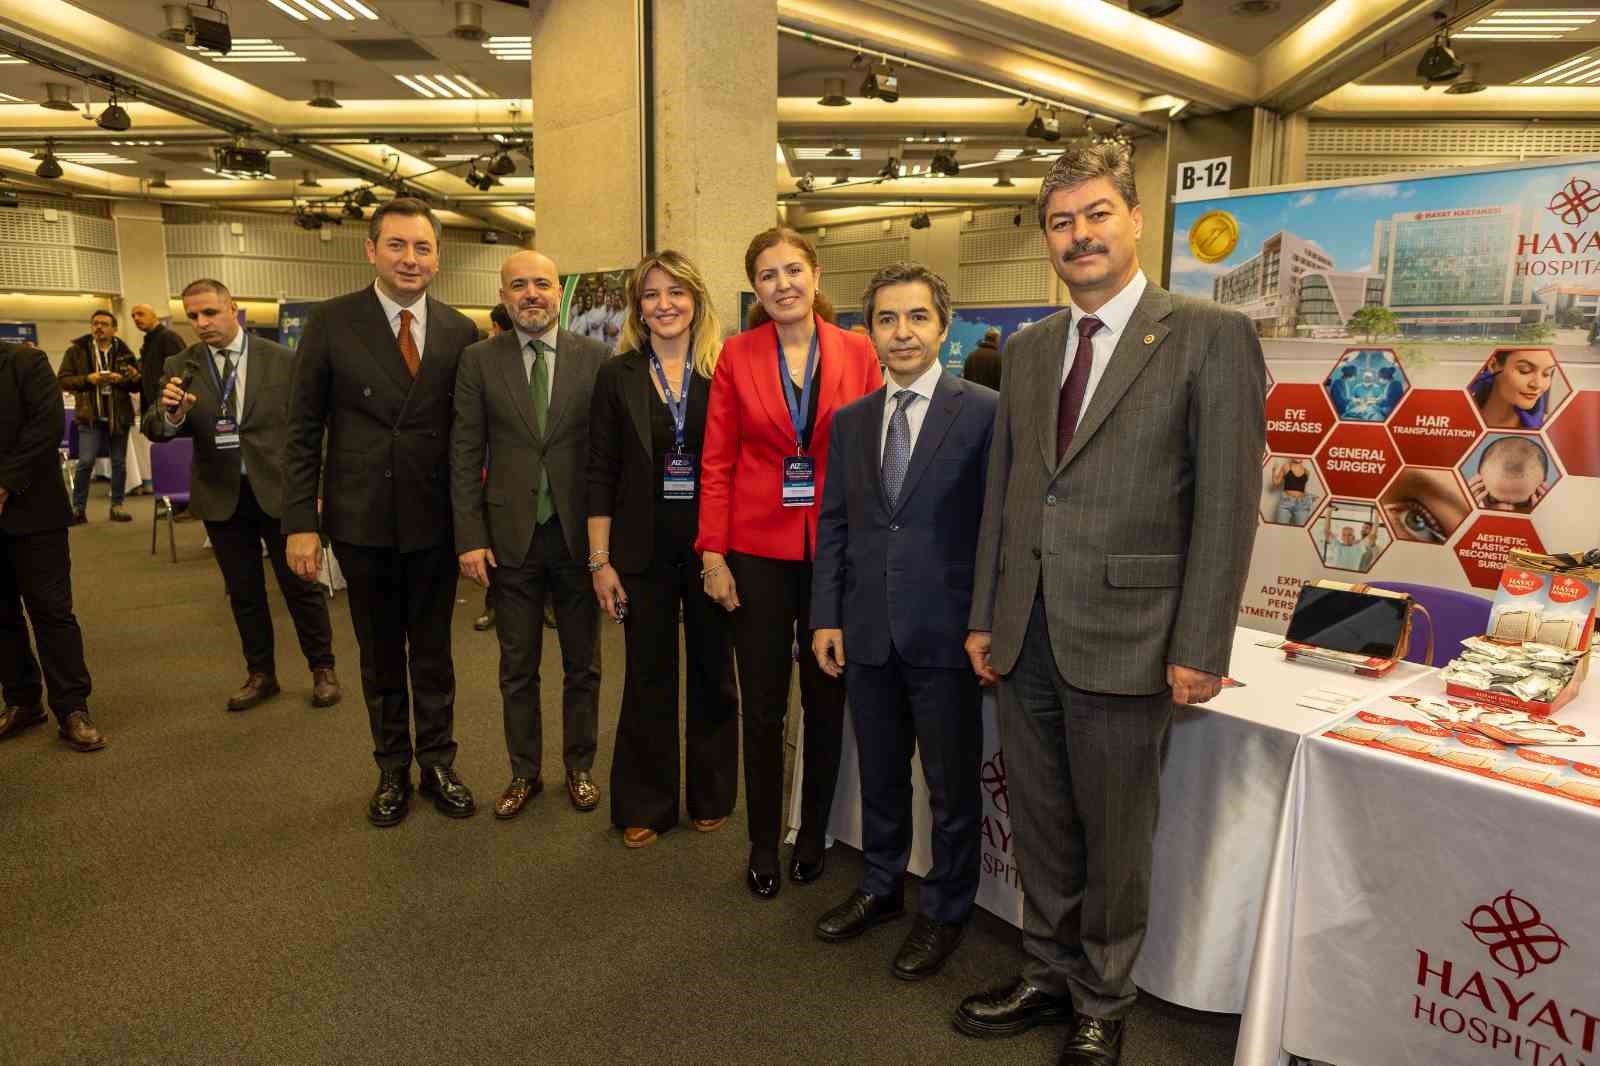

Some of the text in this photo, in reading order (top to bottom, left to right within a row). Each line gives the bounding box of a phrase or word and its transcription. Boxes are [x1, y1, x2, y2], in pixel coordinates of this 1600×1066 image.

[1182, 161, 1228, 190] B-12
[1517, 231, 1600, 255] HAYA
[1284, 408, 1307, 420] EYE
[1267, 420, 1322, 434] DISEASES
[1415, 415, 1450, 428] HAIR
[1393, 426, 1475, 438] TRANSPLANTATION
[1328, 447, 1386, 461] GENERAL
[1326, 460, 1386, 475] SURGERY
[1471, 541, 1509, 553] PLASTIC
[1268, 598, 1296, 610] PERS
[1416, 949, 1600, 1053] HAYAT
[1413, 994, 1585, 1066] HOSPIT
